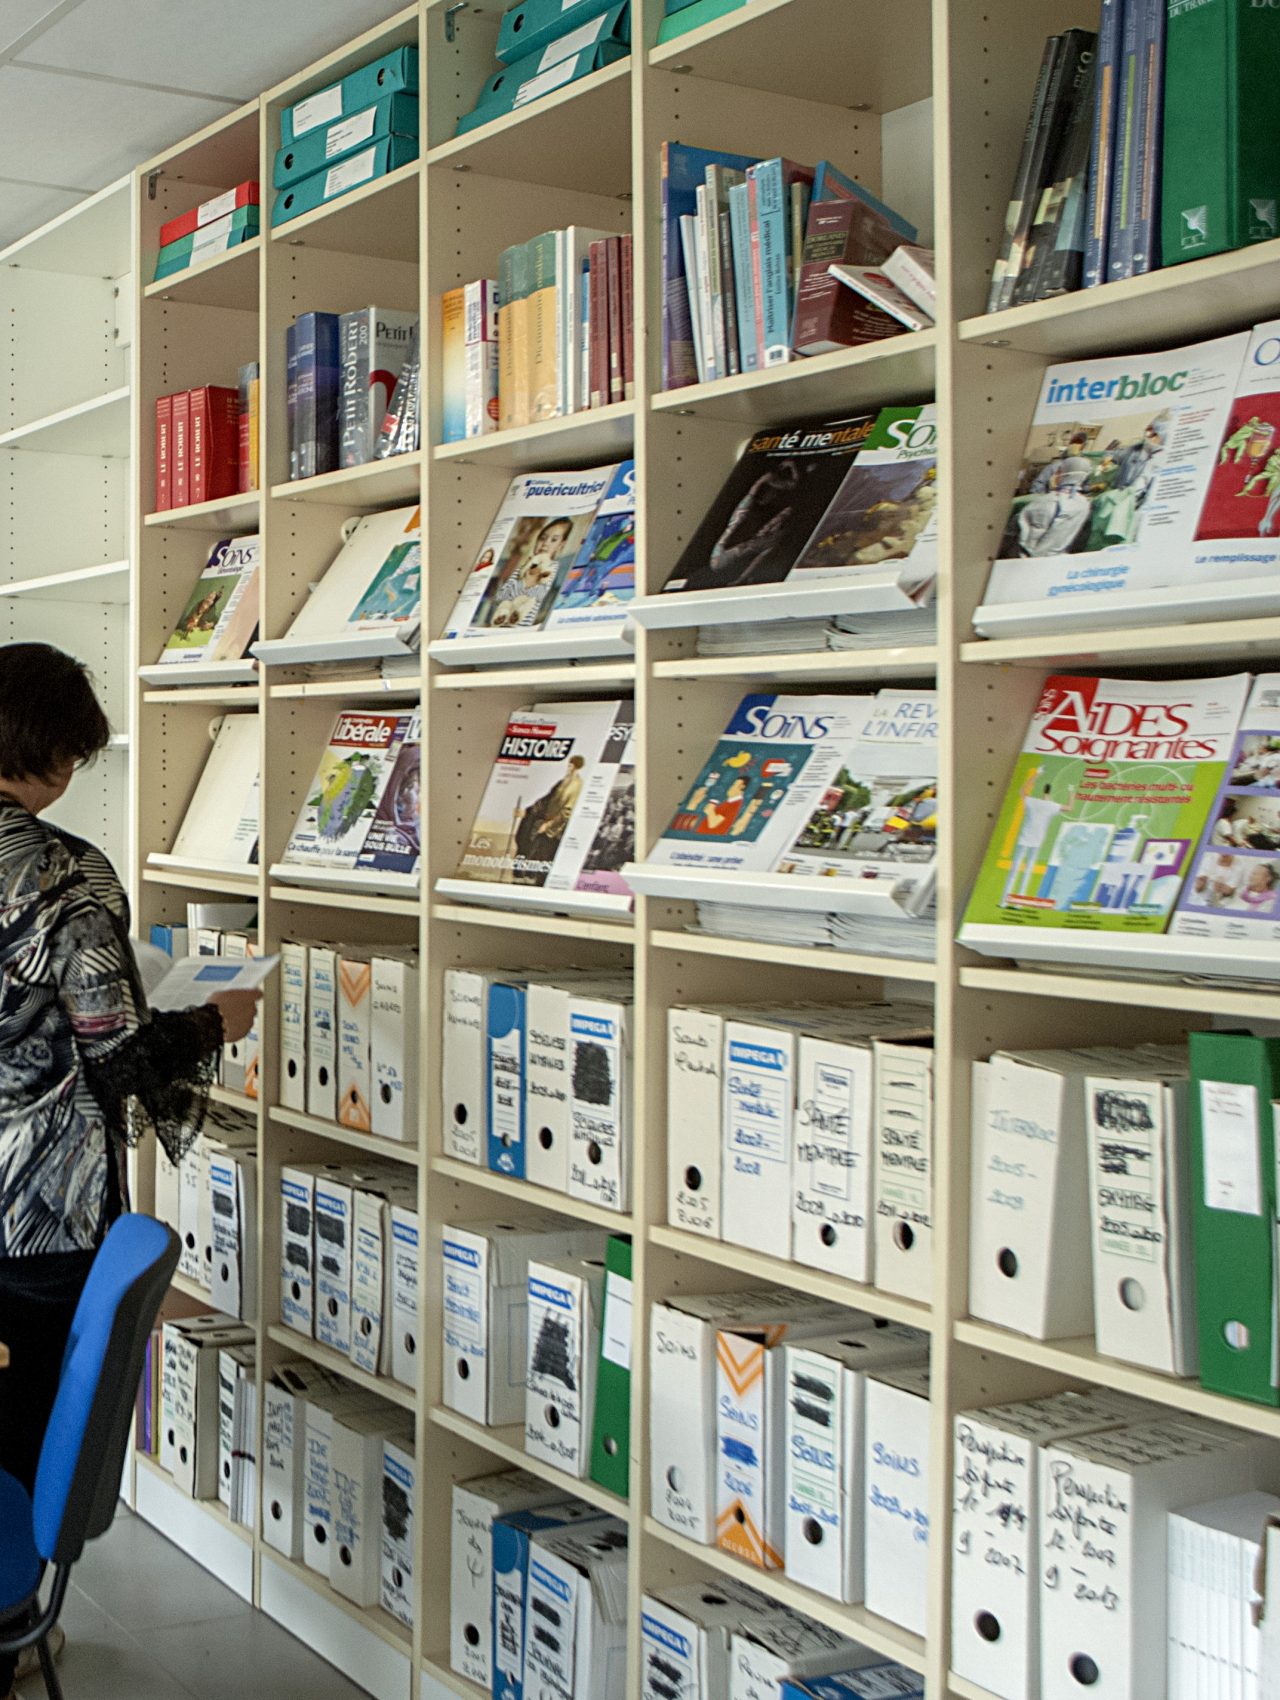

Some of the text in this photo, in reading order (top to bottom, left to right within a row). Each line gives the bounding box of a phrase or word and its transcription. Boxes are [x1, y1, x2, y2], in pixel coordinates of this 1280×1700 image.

[535, 294, 543, 365] Dictionnaire
[1046, 370, 1189, 403] interbloc
[750, 419, 876, 452] santé mentale
[861, 719, 937, 739] L'INFIR
[500, 737, 570, 758] HISTOIRE
